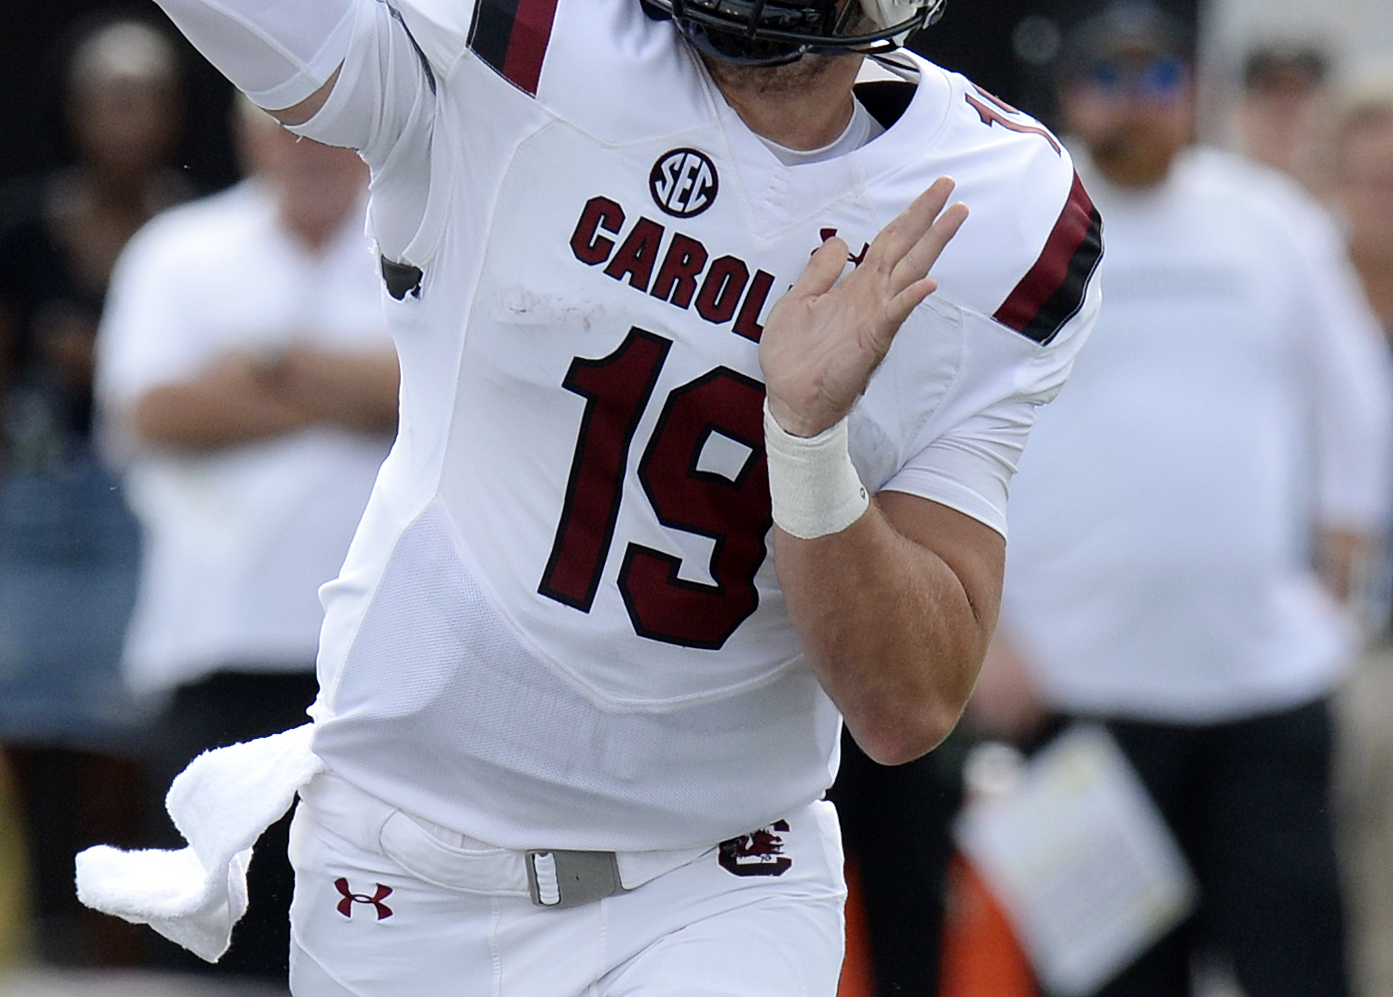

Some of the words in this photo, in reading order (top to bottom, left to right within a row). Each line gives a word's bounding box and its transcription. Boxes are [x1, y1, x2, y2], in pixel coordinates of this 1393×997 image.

[654, 151, 714, 214] SEC
[569, 195, 776, 345] CAROL
[537, 325, 773, 650] 19
